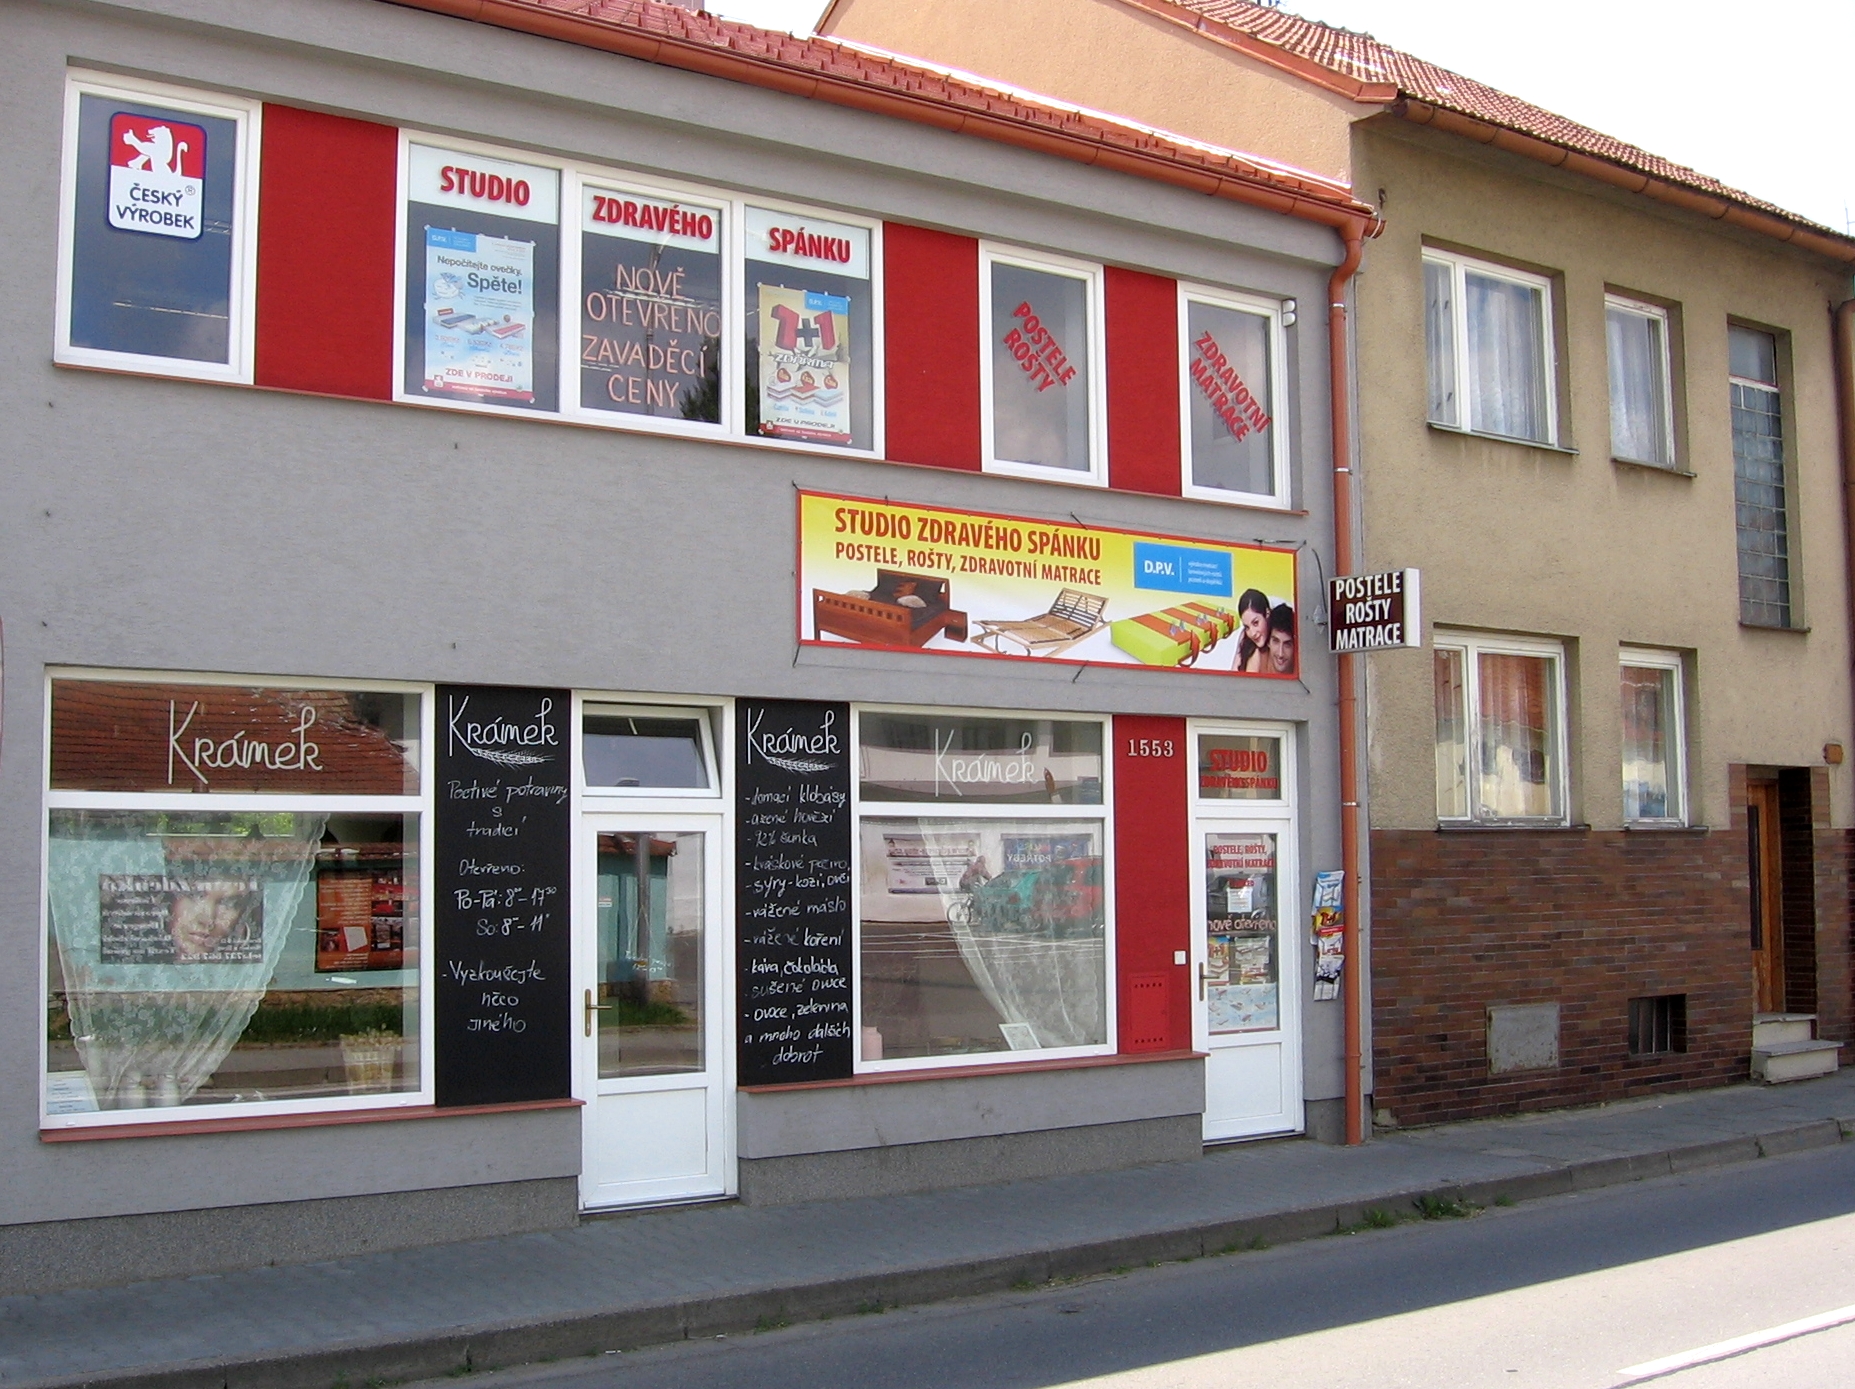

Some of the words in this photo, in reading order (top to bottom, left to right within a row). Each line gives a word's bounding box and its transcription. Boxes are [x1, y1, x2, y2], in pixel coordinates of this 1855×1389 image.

[116, 203, 195, 230] VÝROBEK
[129, 182, 183, 207] ČESKÝ
[441, 165, 530, 206] STUDIO
[593, 195, 713, 240] ZDRAVÉHO
[769, 227, 851, 263] SPÁNKU
[467, 272, 522, 295] Spěte!
[617, 264, 685, 299] NOVĚ
[582, 334, 708, 378] ZAVADĚCÍ
[1003, 327, 1056, 392] ROŠTY
[1011, 300, 1077, 387] POSTELE
[608, 373, 680, 408] CENY
[1190, 358, 1250, 443] MATRACE
[1194, 330, 1273, 434] ZDRAVOTNÍ
[835, 507, 911, 540] STUDIO
[917, 517, 1022, 552] ZDRAVÉHO
[1028, 528, 1101, 561] SPÁNKU
[836, 541, 903, 568] POSTELE,
[907, 548, 956, 573] ROŠTY,
[960, 555, 1038, 579] ZDRAVOTNÍ
[1041, 564, 1101, 586] MATRACE
[1144, 560, 1175, 576] D.P.V.
[1335, 572, 1401, 600] POSTELE
[1345, 595, 1391, 624] ROŠTY
[1336, 623, 1401, 650] MATRACE
[167, 699, 323, 785] Krámek
[449, 694, 559, 757] Krámek
[747, 707, 841, 764] Krámek
[935, 728, 1039, 797] Krámek
[1127, 738, 1174, 758] 1553
[1209, 749, 1268, 773] STUDIO
